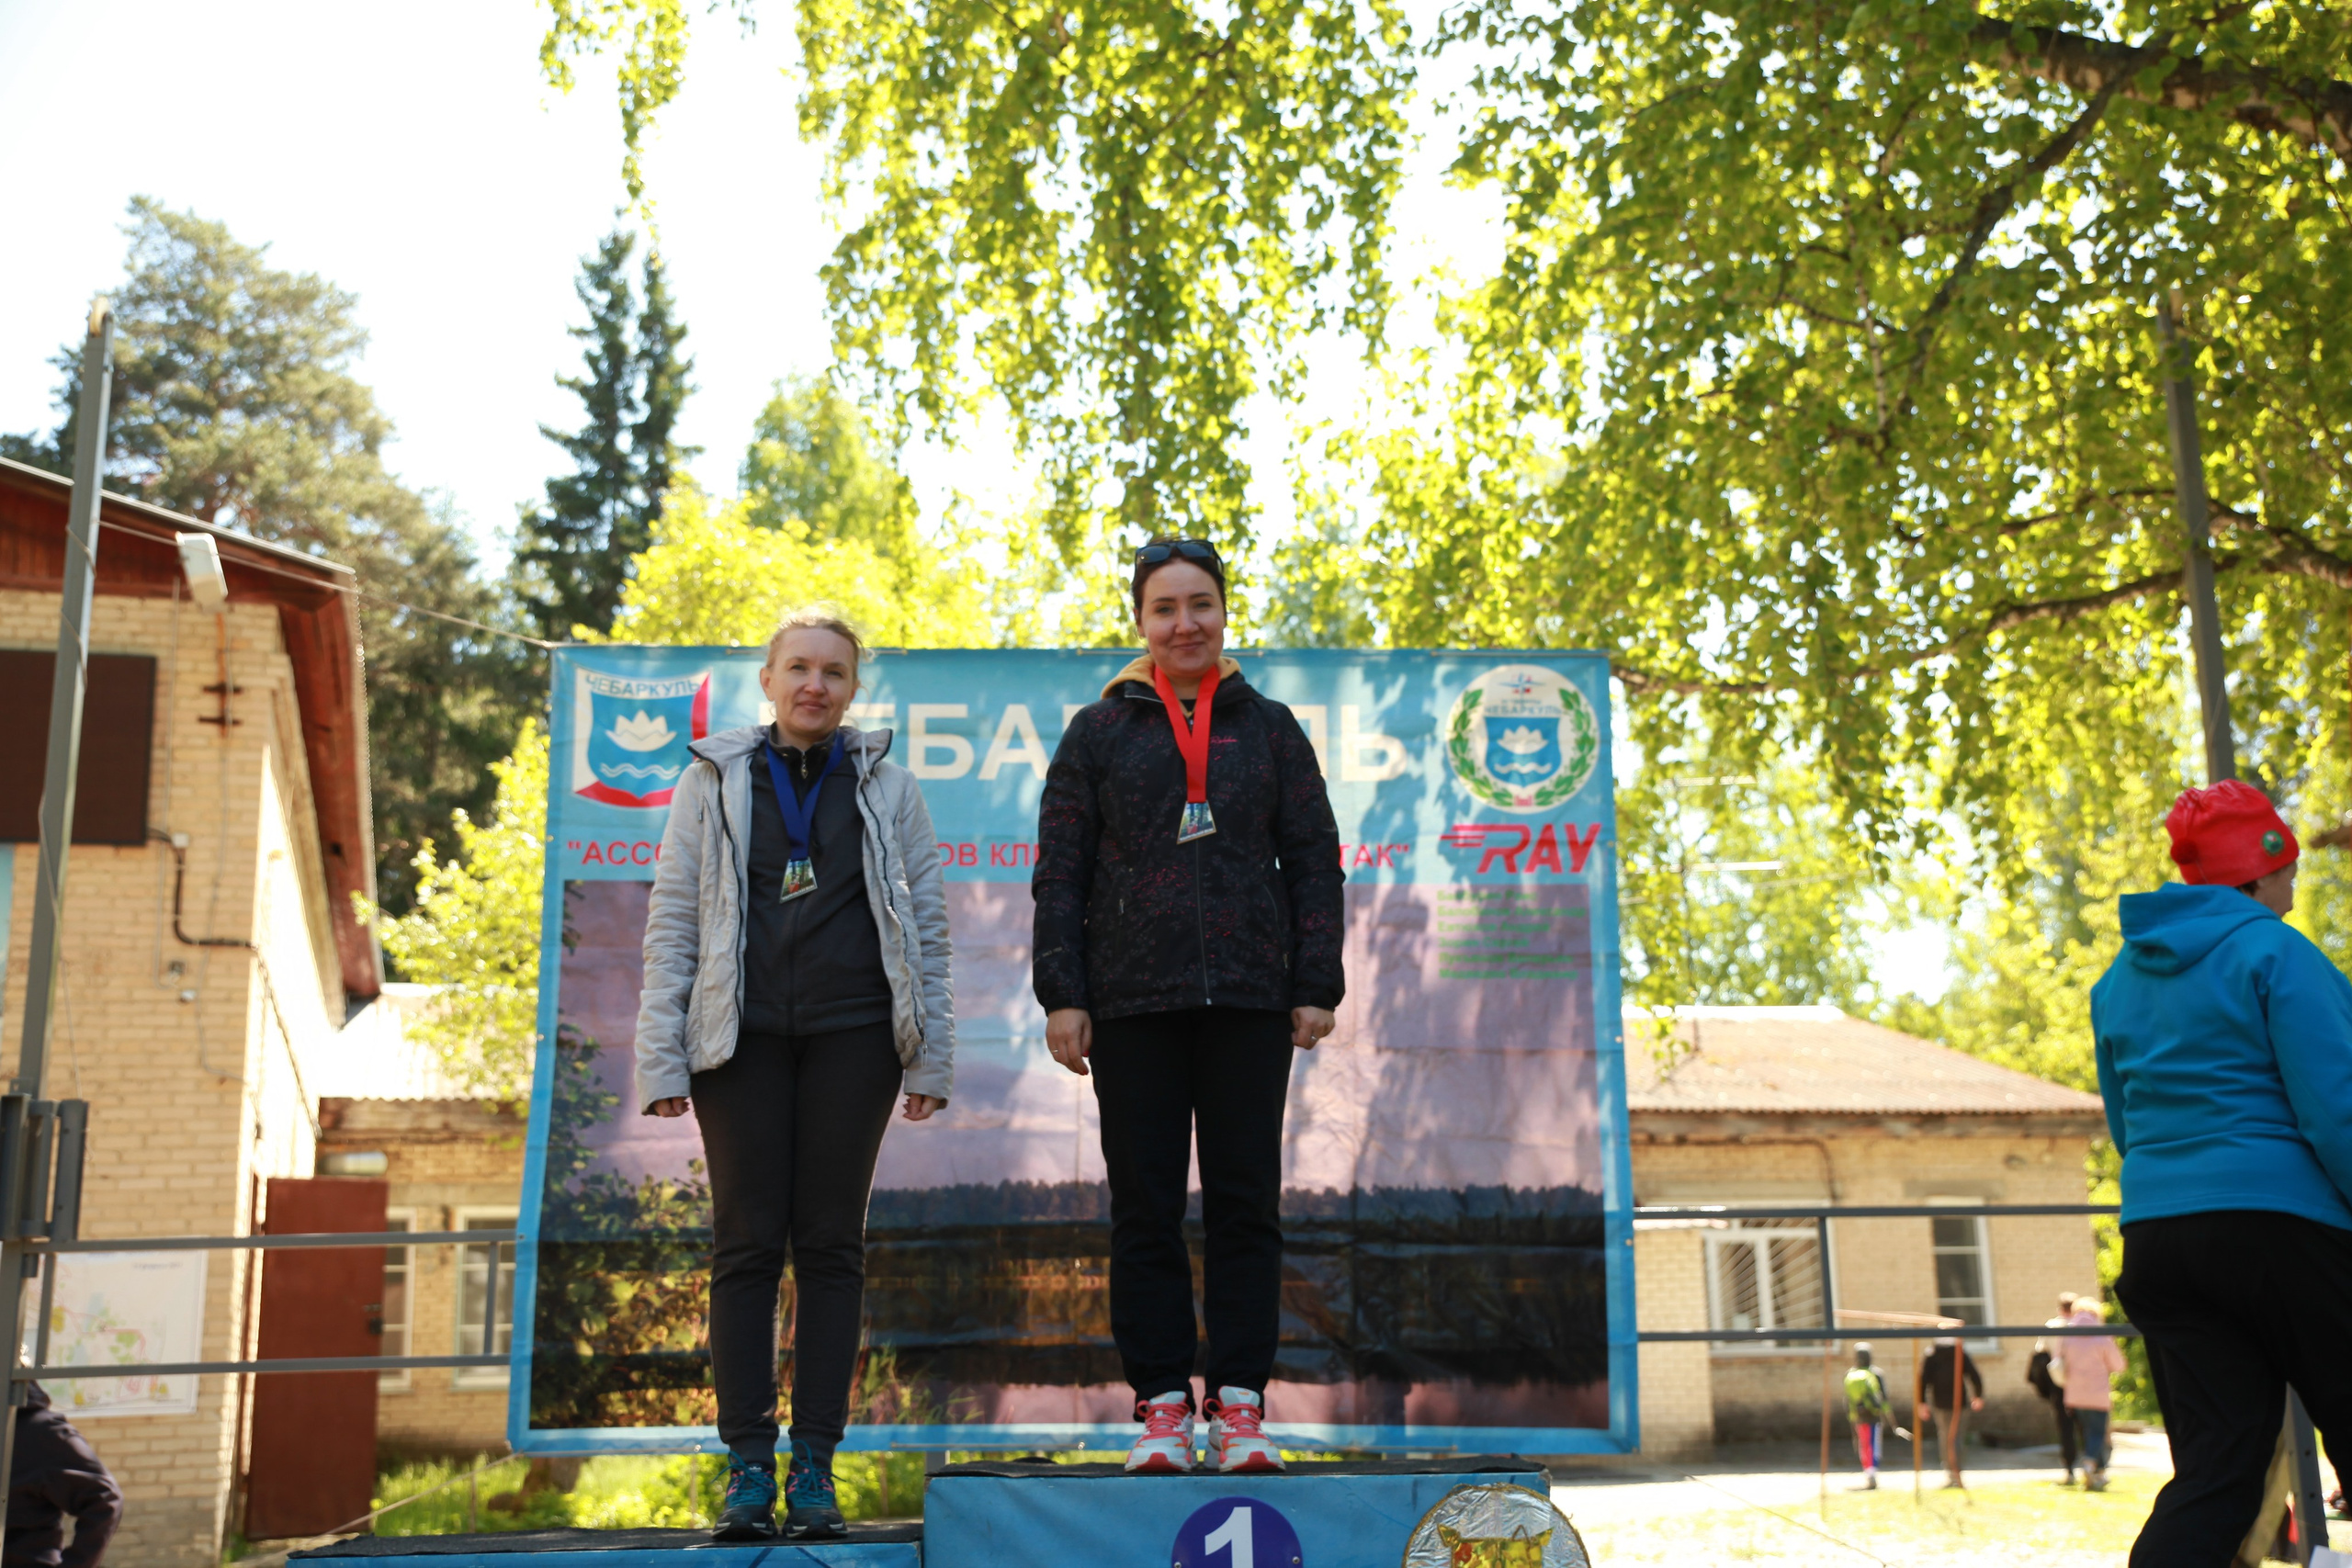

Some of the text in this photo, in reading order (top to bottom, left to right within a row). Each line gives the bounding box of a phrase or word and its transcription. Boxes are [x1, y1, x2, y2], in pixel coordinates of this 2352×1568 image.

[585, 674, 701, 696] ЧЕБАРКУЛЬ
[1440, 823, 1601, 874] RAY
[1204, 1506, 1254, 1568] 1
